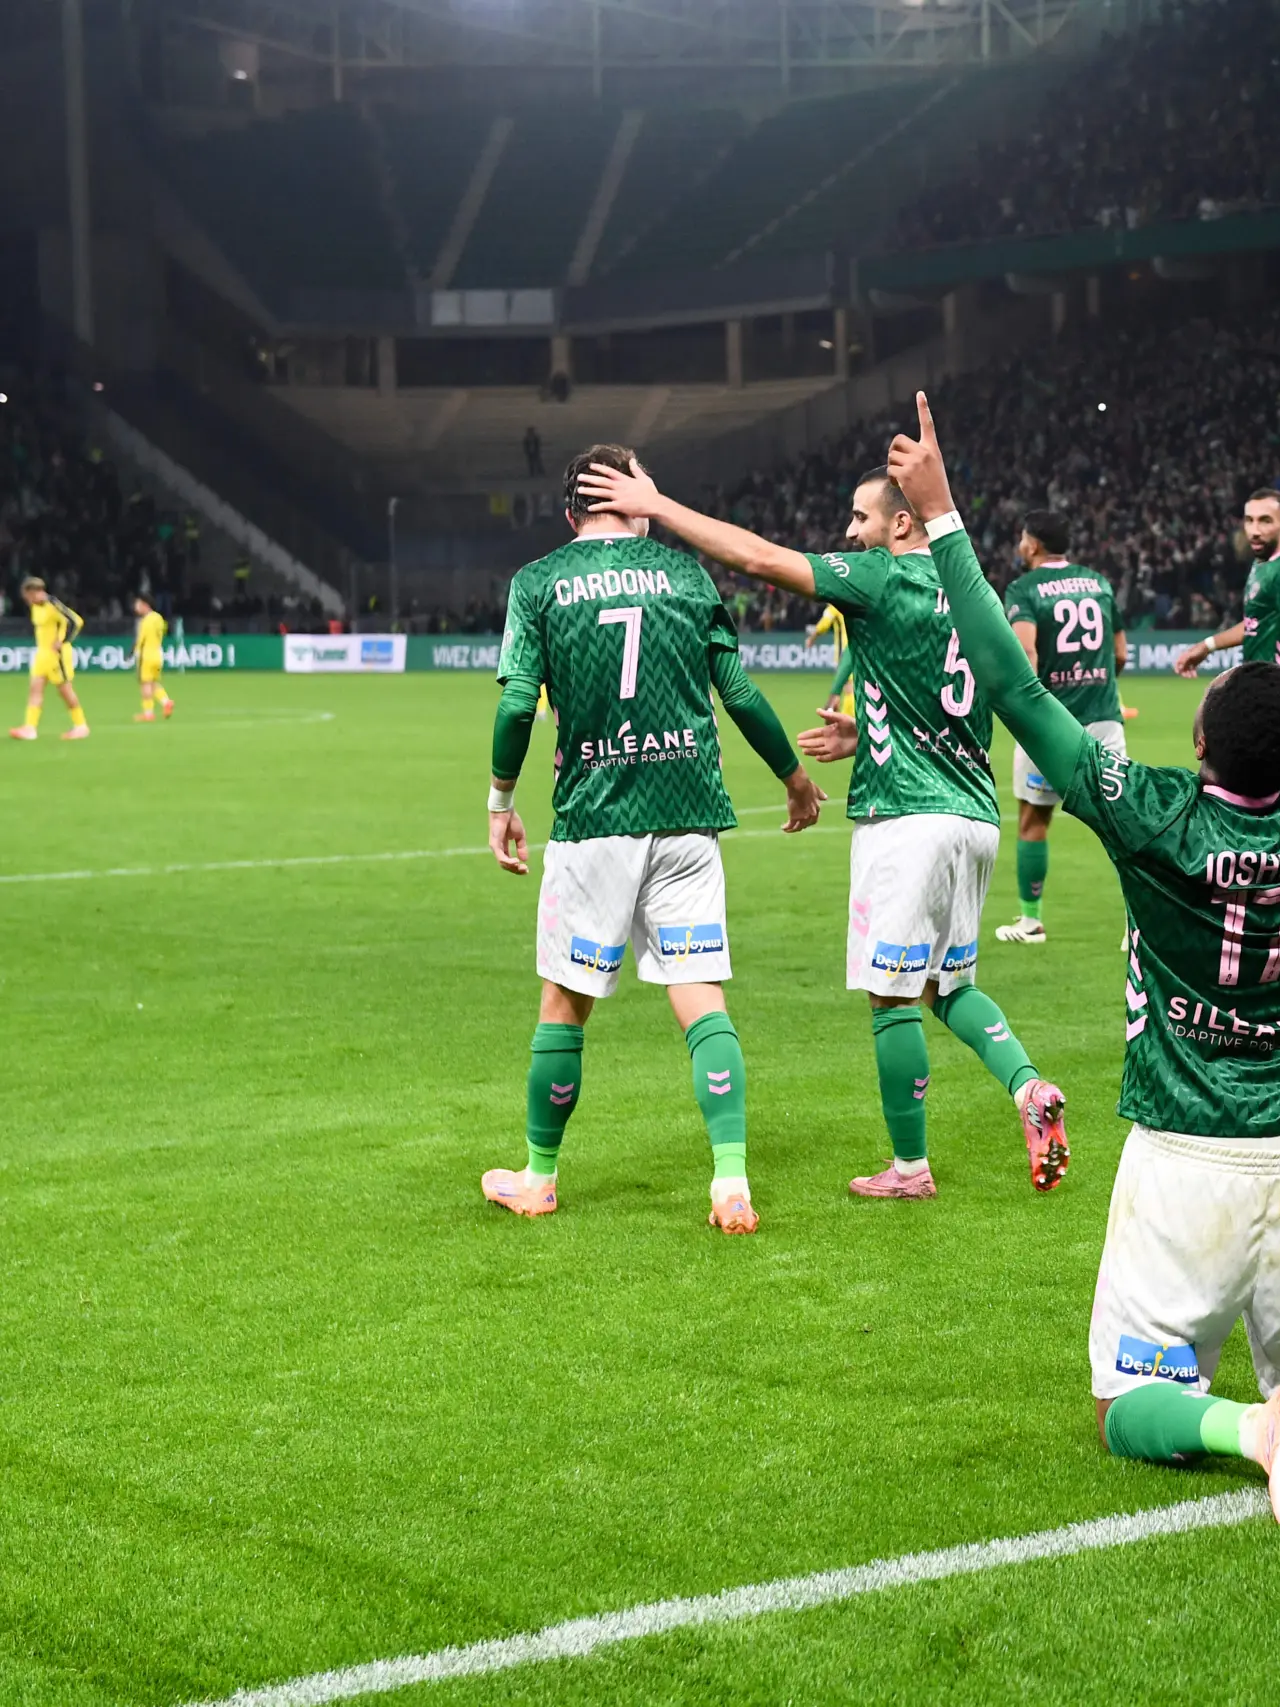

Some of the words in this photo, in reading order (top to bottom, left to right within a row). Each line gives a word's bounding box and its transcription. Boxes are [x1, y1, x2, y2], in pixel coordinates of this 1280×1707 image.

[555, 569, 672, 606] CARDONA
[1053, 598, 1103, 653] 29
[433, 645, 470, 668] VIVEZ
[598, 607, 642, 699] 7
[583, 756, 636, 772] ADAPTIVE
[641, 748, 698, 763] ROBOTICS
[1166, 1022, 1243, 1047] ADAPTIVE
